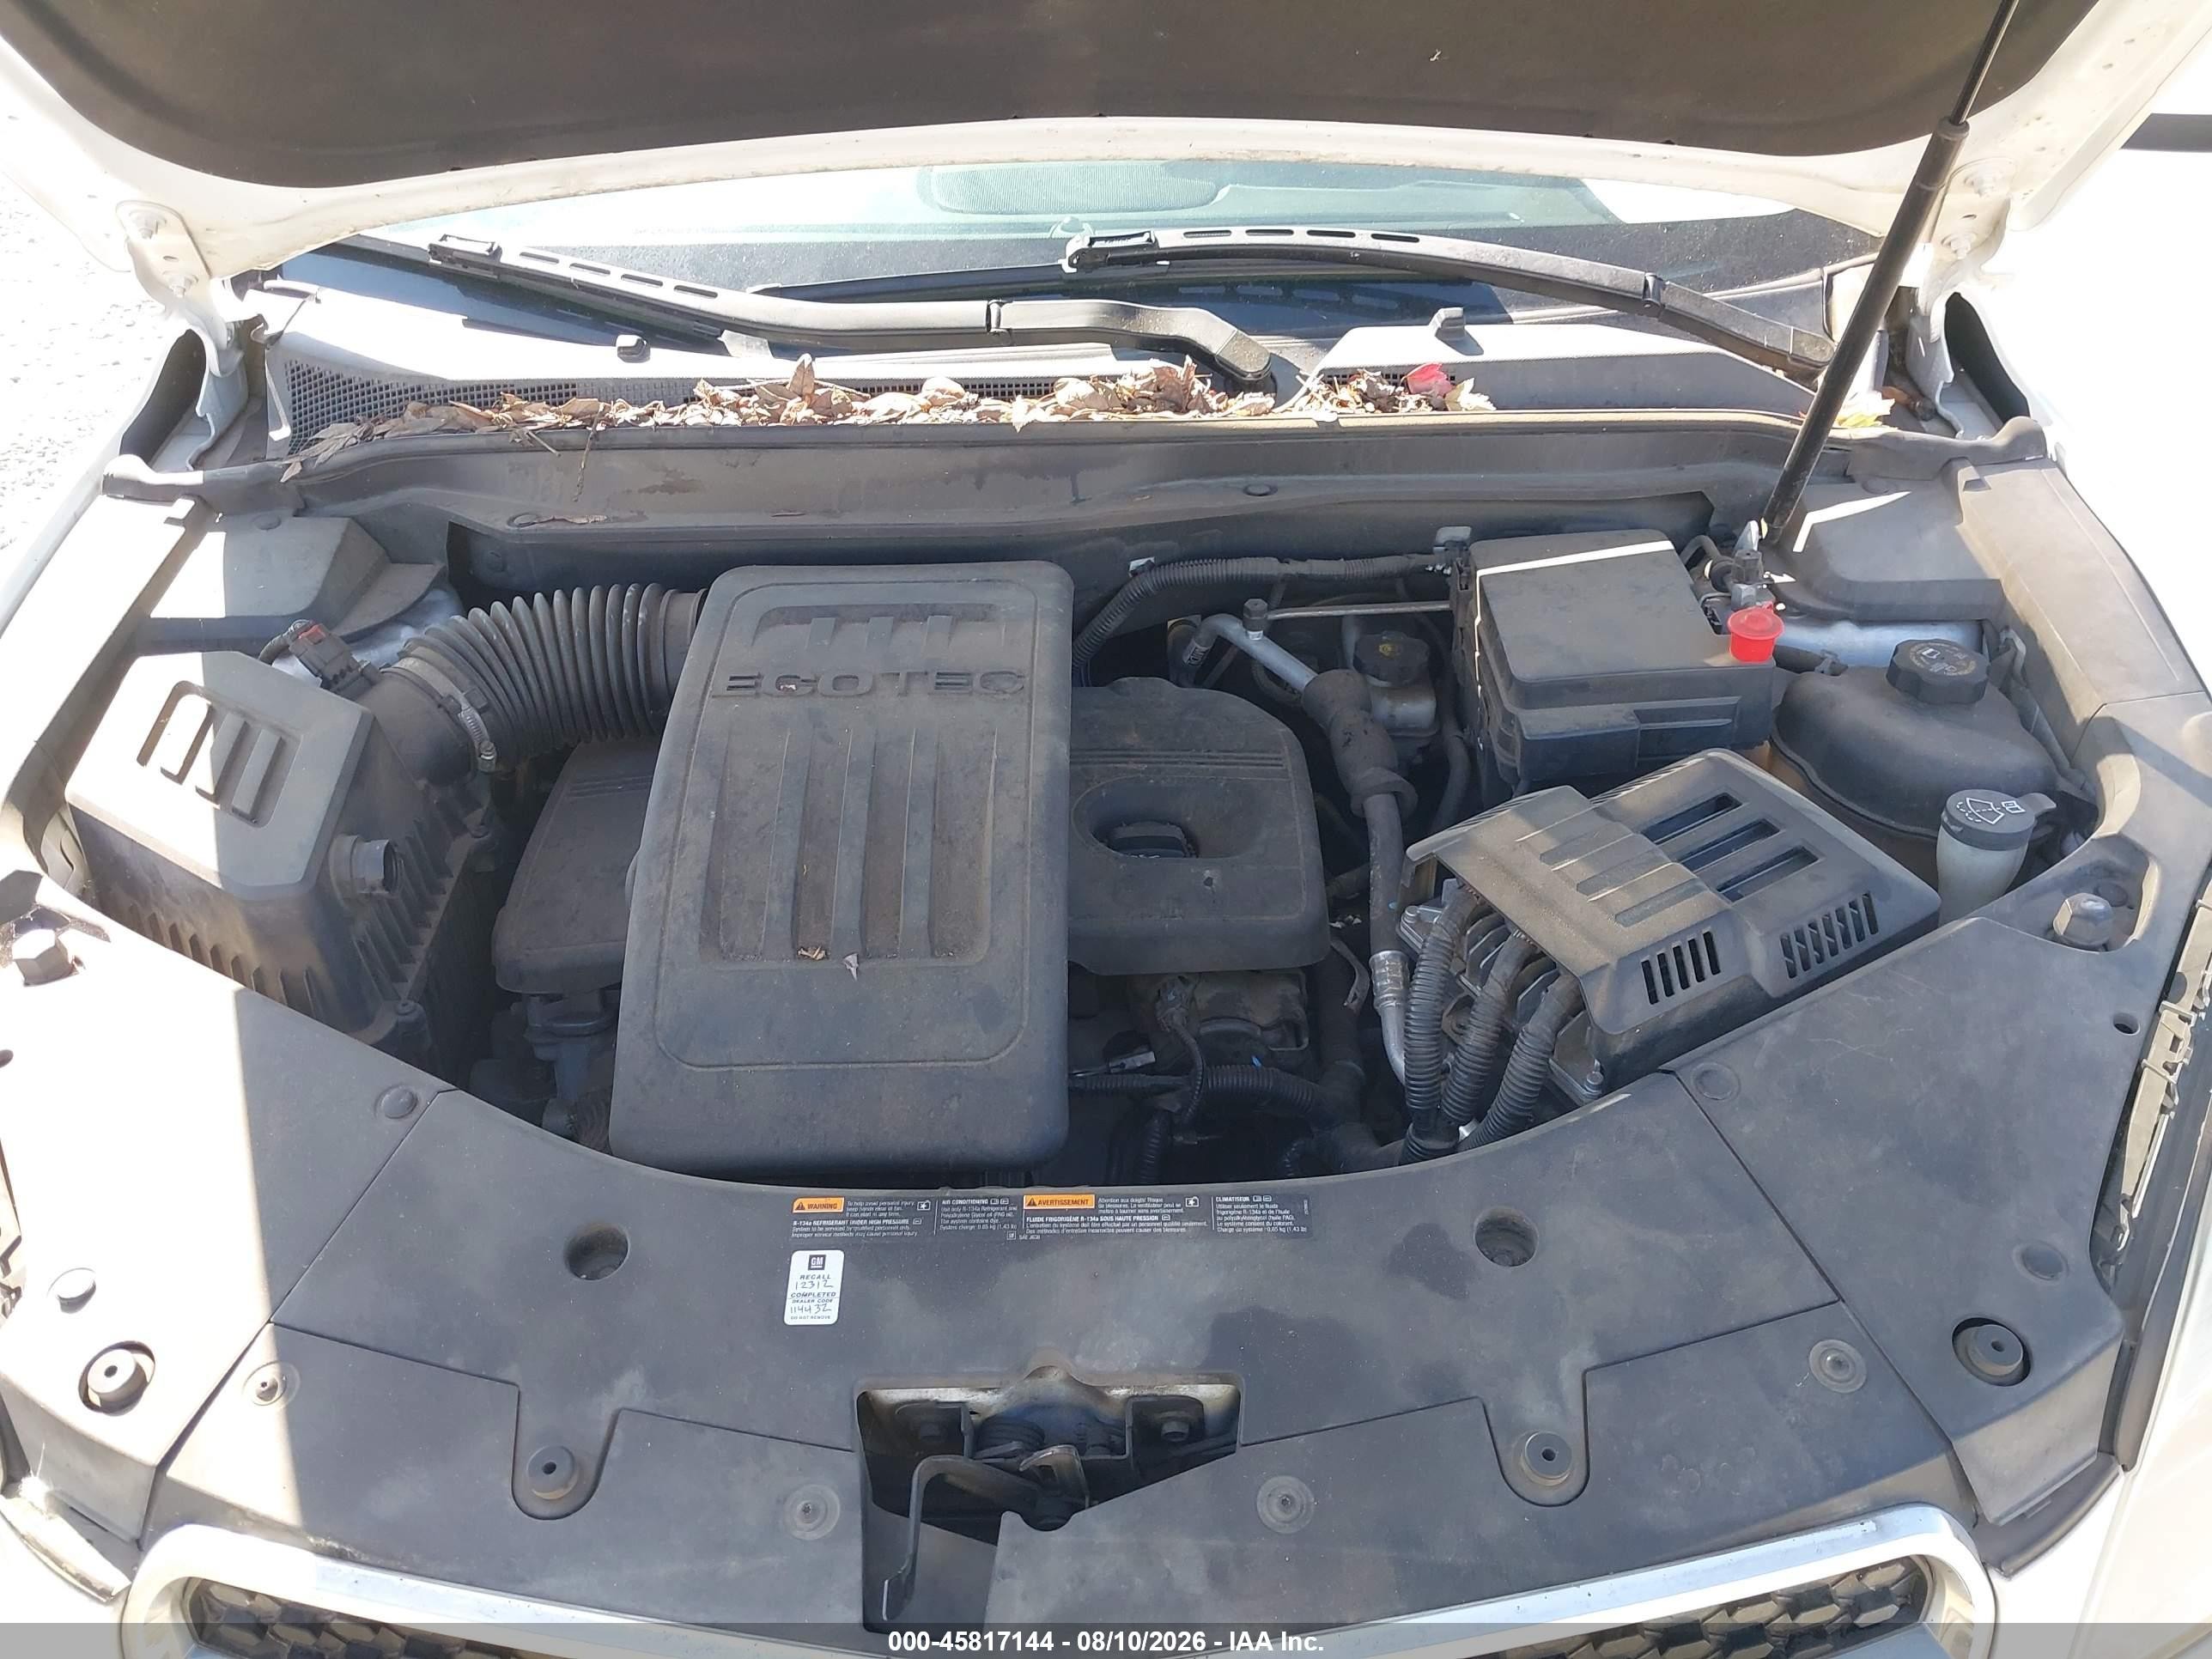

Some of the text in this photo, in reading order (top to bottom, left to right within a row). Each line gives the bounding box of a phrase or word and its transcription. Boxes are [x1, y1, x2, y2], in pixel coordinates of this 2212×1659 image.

[712, 670, 1025, 698] ECOTEC
[811, 1257, 824, 1265] GM
[795, 1279, 834, 1290] 12312
